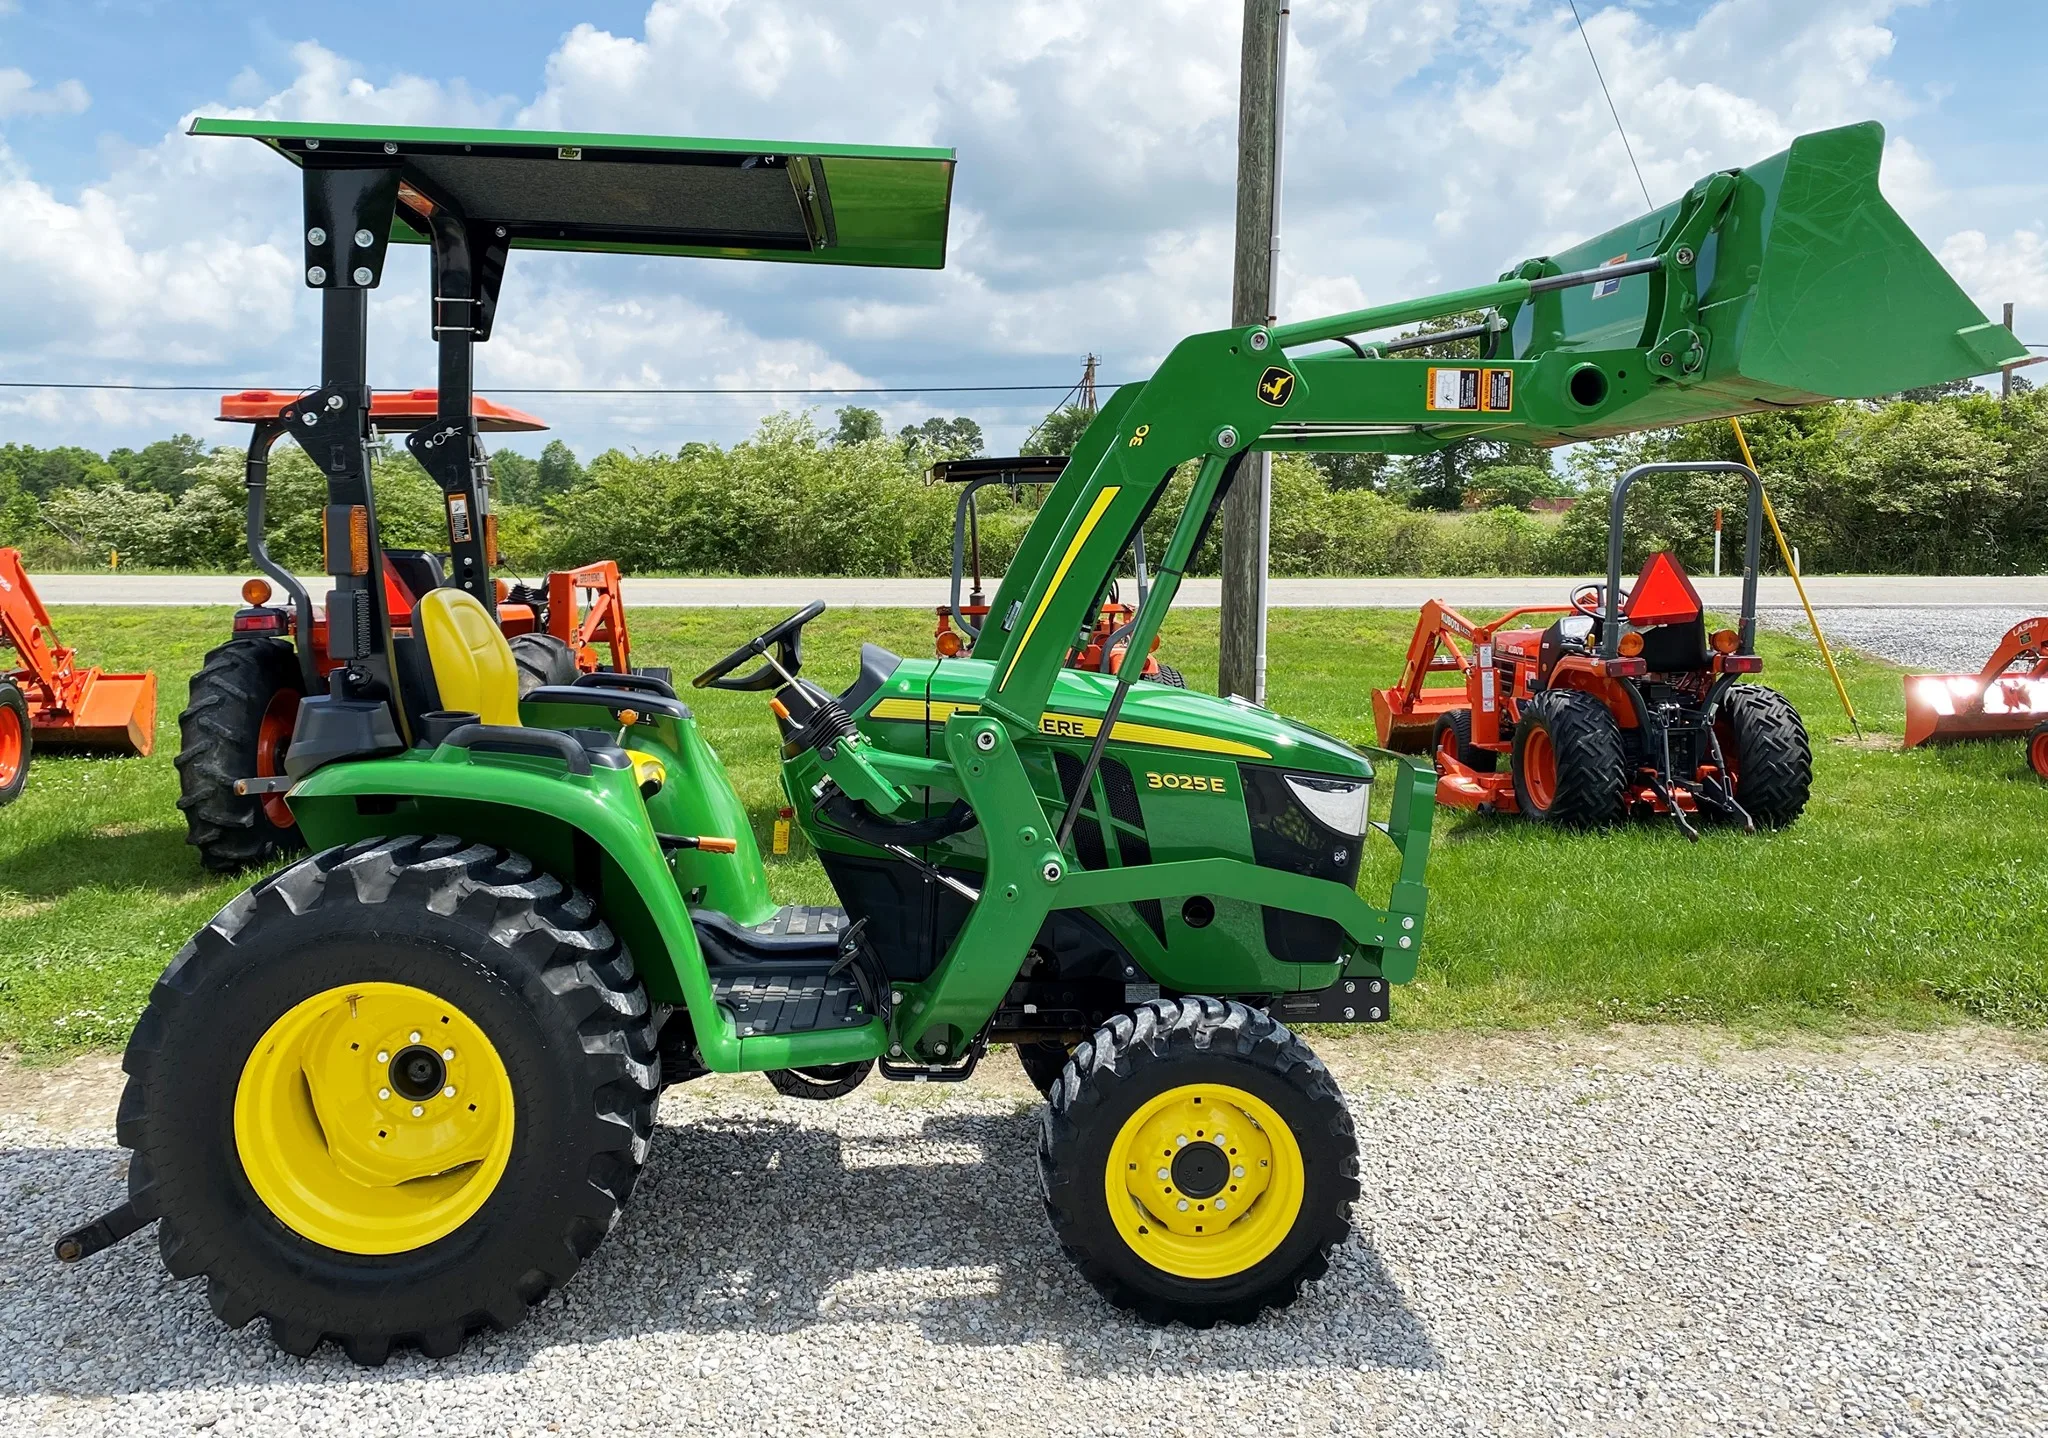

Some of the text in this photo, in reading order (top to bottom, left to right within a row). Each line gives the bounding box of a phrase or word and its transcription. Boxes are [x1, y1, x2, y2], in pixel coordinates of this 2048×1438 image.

[1128, 424, 1150, 448] 30
[2012, 620, 2039, 637] LA344
[1038, 718, 1085, 737] ERE
